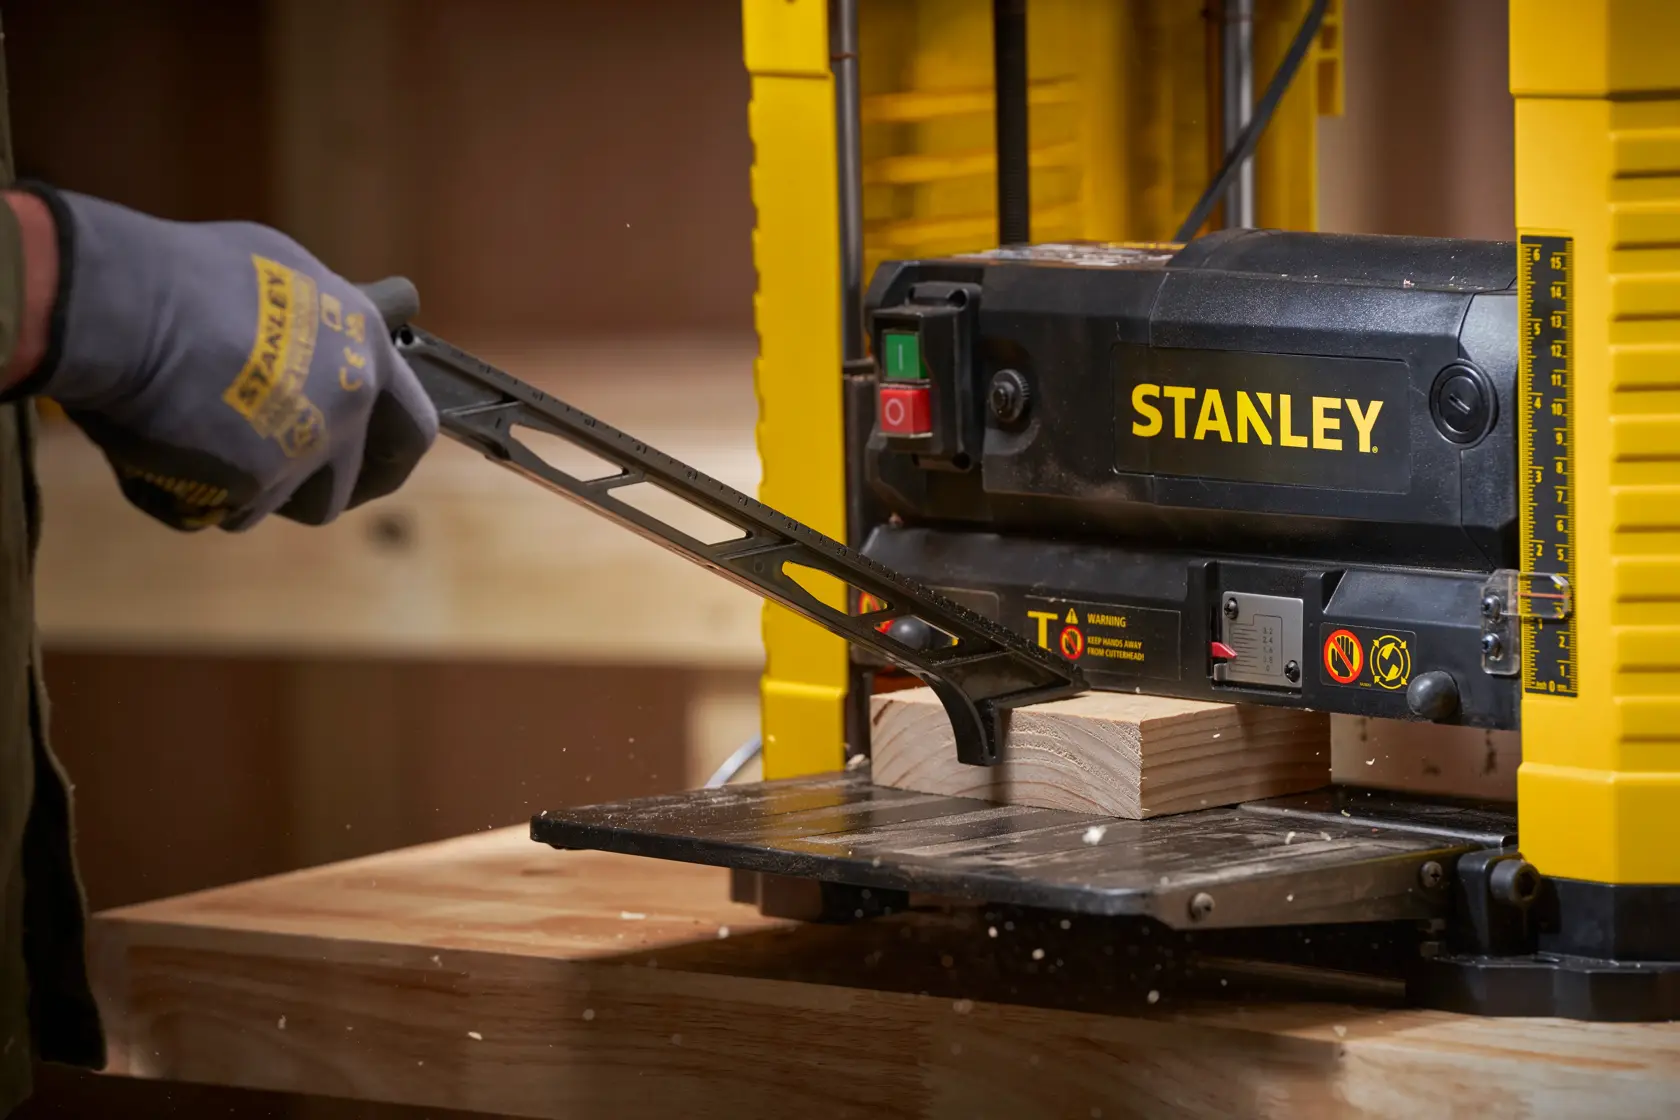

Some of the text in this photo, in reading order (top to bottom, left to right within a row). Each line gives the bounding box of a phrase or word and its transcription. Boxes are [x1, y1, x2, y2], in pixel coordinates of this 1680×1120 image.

[1532, 248, 1541, 261] 6
[1550, 257, 1562, 269] 15
[1550, 286, 1562, 299] 14
[1550, 316, 1562, 328] 13
[1533, 323, 1541, 336] 5
[238, 268, 288, 405] STANLEY
[1551, 345, 1563, 357] 12
[1551, 374, 1562, 387] 11
[1533, 396, 1542, 409] 4
[1551, 403, 1563, 416] 10
[1131, 383, 1384, 454] STANLEY
[1555, 432, 1563, 445] 9
[1555, 461, 1563, 474] 8
[1535, 471, 1542, 483] 3
[1556, 491, 1564, 503] 7
[1556, 519, 1564, 532] 6
[1536, 544, 1543, 557] 2
[1557, 548, 1564, 561] 5
[1087, 612, 1127, 628] WARNING
[1087, 635, 1143, 650] KEEP HANDS AWAY
[1558, 636, 1565, 648] 2
[1087, 646, 1105, 657] FROM
[1559, 665, 1565, 677] 1
[1548, 680, 1555, 692] 0
